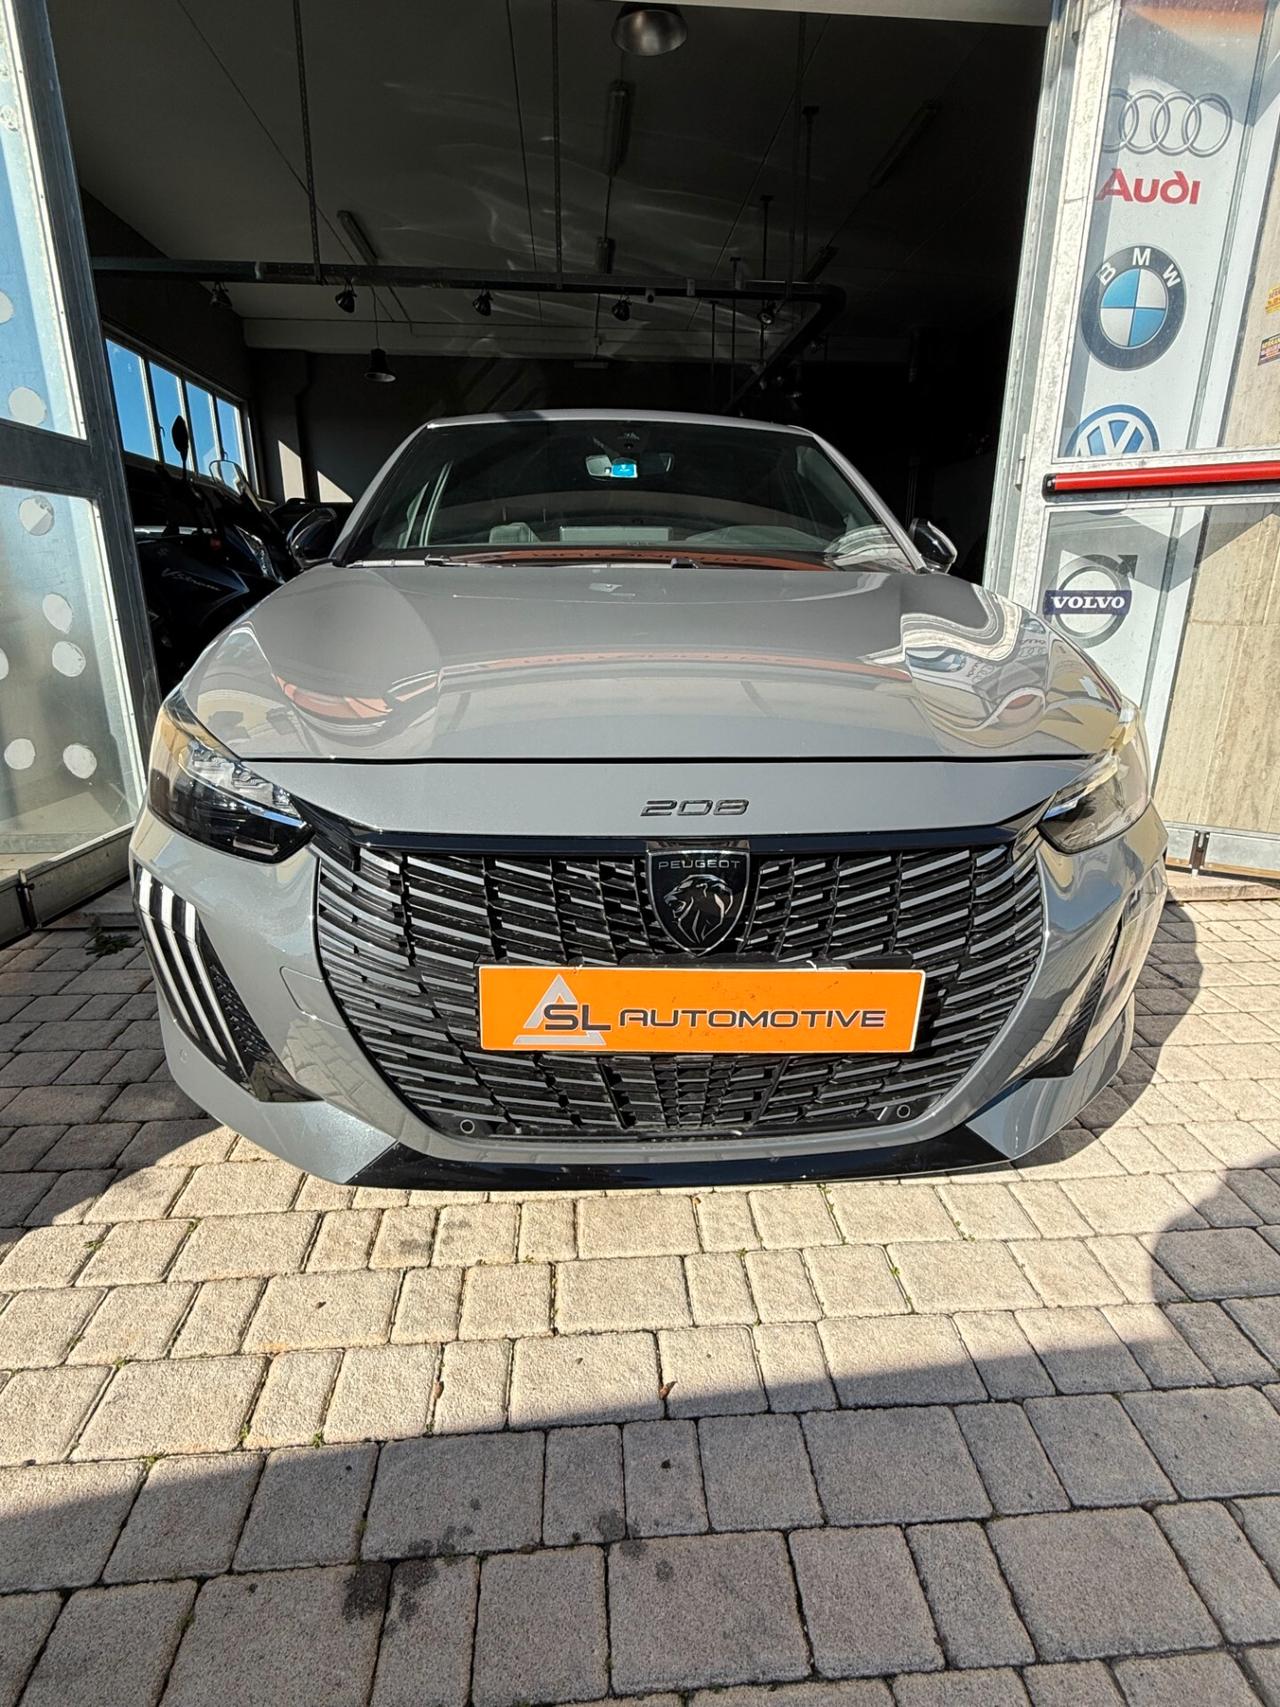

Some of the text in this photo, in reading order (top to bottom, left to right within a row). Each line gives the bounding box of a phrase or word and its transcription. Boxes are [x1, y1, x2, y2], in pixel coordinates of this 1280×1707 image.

[1094, 167, 1201, 205] Audi
[1096, 247, 1181, 286] BMW
[1053, 596, 1125, 609] VOLVO
[640, 799, 749, 816] 208
[658, 859, 741, 870] PEUGEOT
[619, 1009, 887, 1028] AUTOMOTIVE
